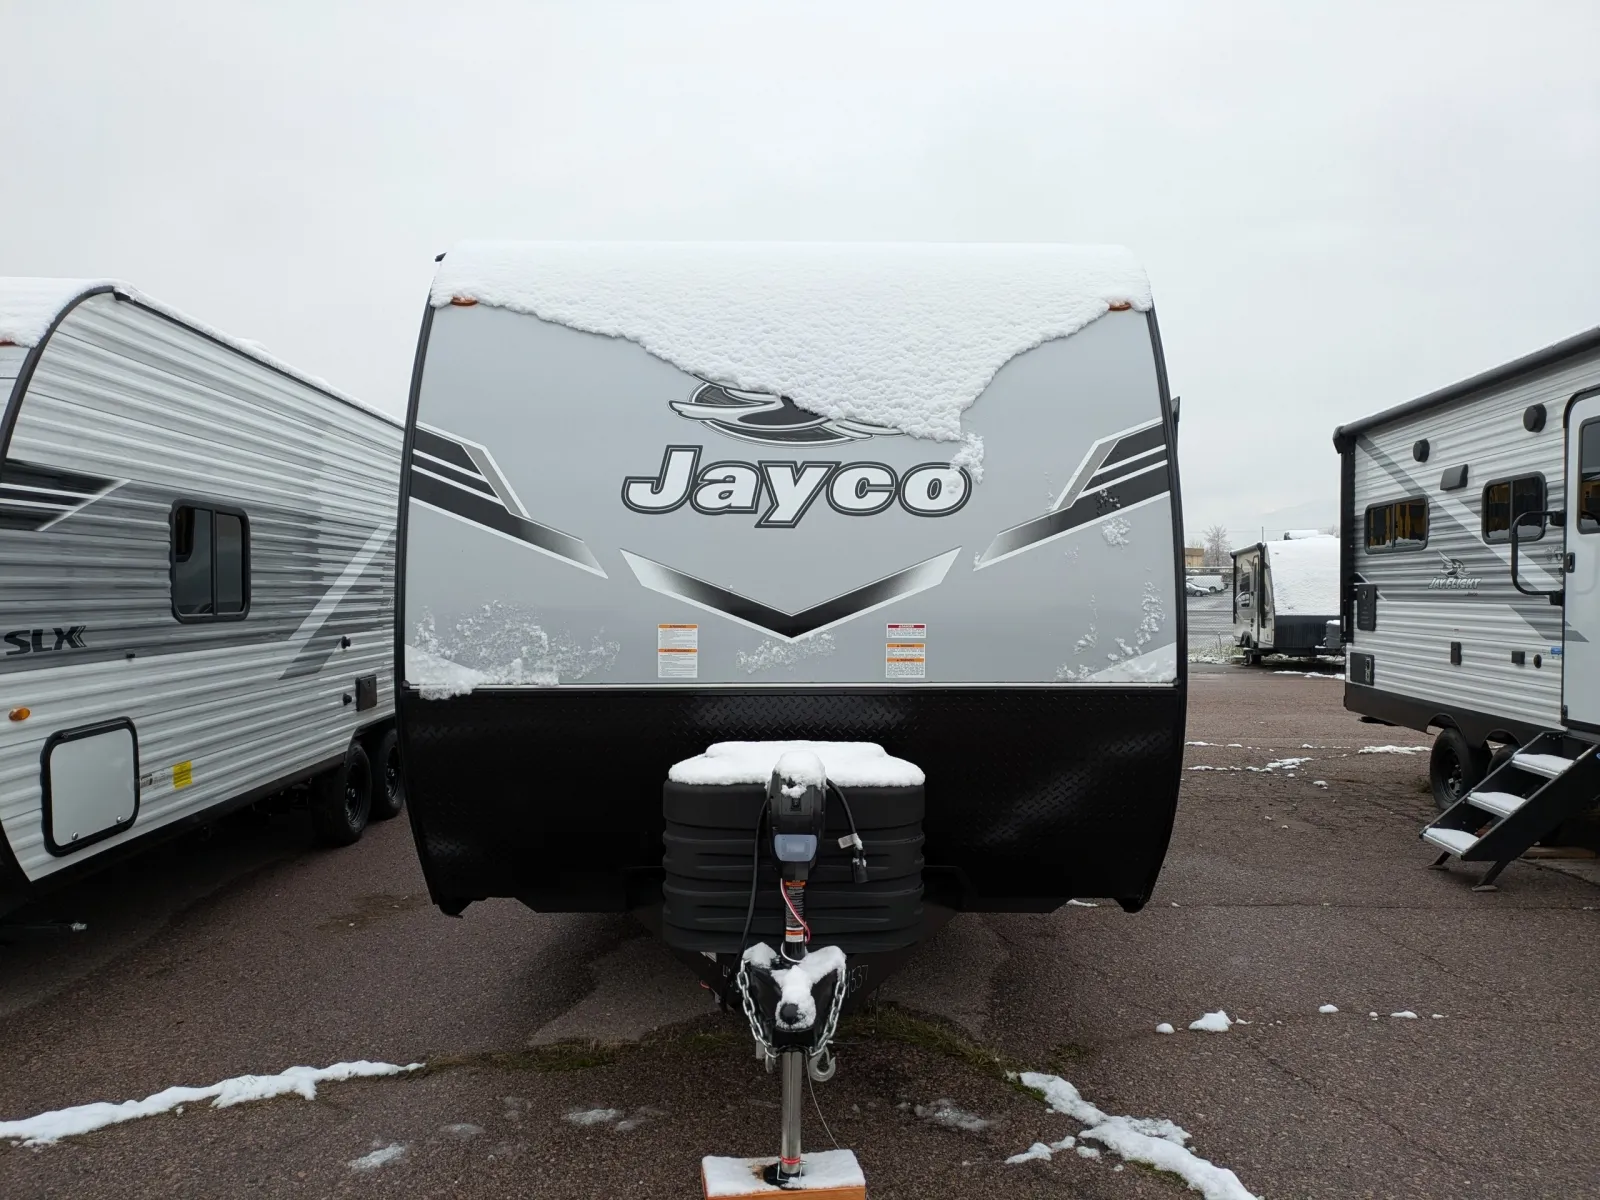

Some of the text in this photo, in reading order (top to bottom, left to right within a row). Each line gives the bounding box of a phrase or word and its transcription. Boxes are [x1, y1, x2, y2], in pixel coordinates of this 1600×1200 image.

[621, 444, 973, 529] Jayco
[1445, 577, 1482, 590] FLIGHT
[4, 625, 87, 656] SLX
